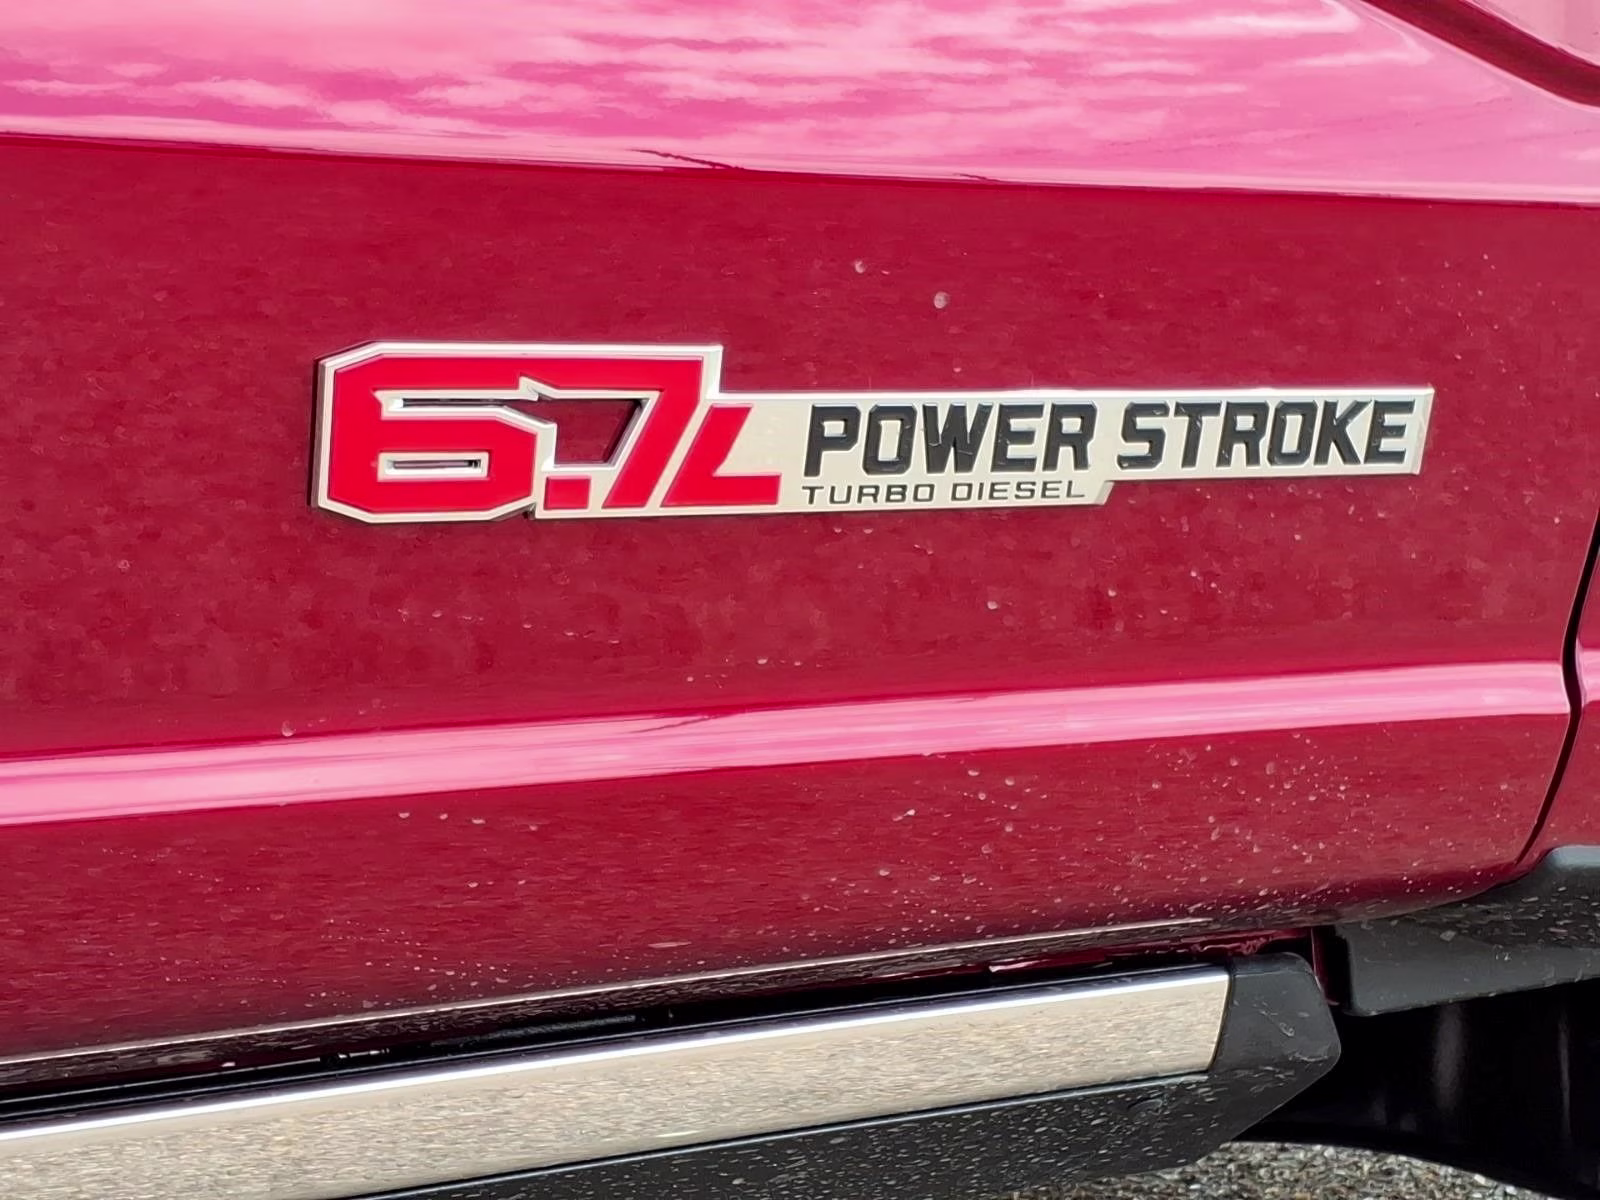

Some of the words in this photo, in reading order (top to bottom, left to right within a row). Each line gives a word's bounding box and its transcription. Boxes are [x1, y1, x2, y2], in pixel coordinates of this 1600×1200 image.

[327, 353, 781, 514] 6.7L
[803, 402, 1098, 477] POWER
[1116, 400, 1416, 470] STROKE
[802, 482, 936, 505] TURBO
[950, 480, 1086, 502] DIESEL
